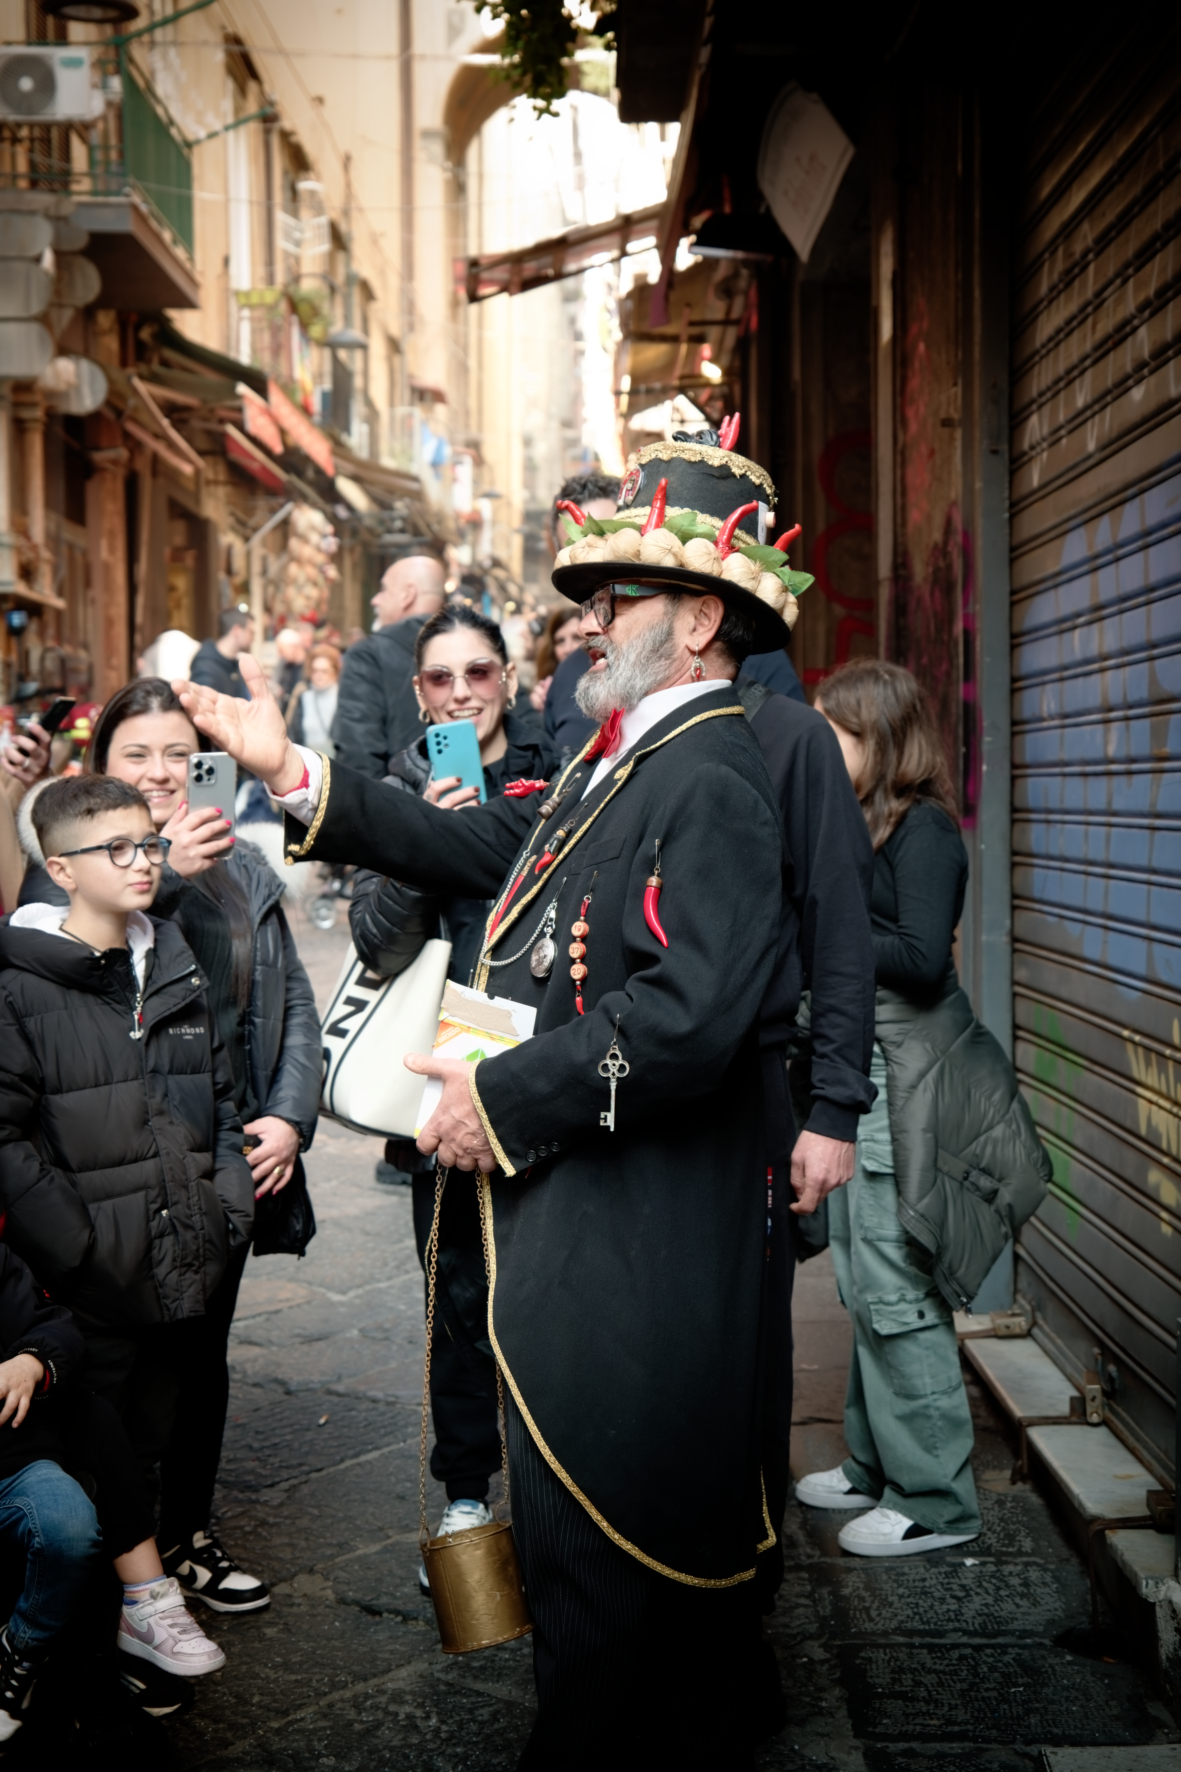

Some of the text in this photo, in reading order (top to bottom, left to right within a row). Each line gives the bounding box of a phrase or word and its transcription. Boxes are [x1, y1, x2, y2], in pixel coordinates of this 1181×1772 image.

[570, 946, 580, 955] 37
[571, 967, 582, 976] 20
[168, 1026, 205, 1035] RICHMOND
[437, 1026, 462, 1043] GROSSO
